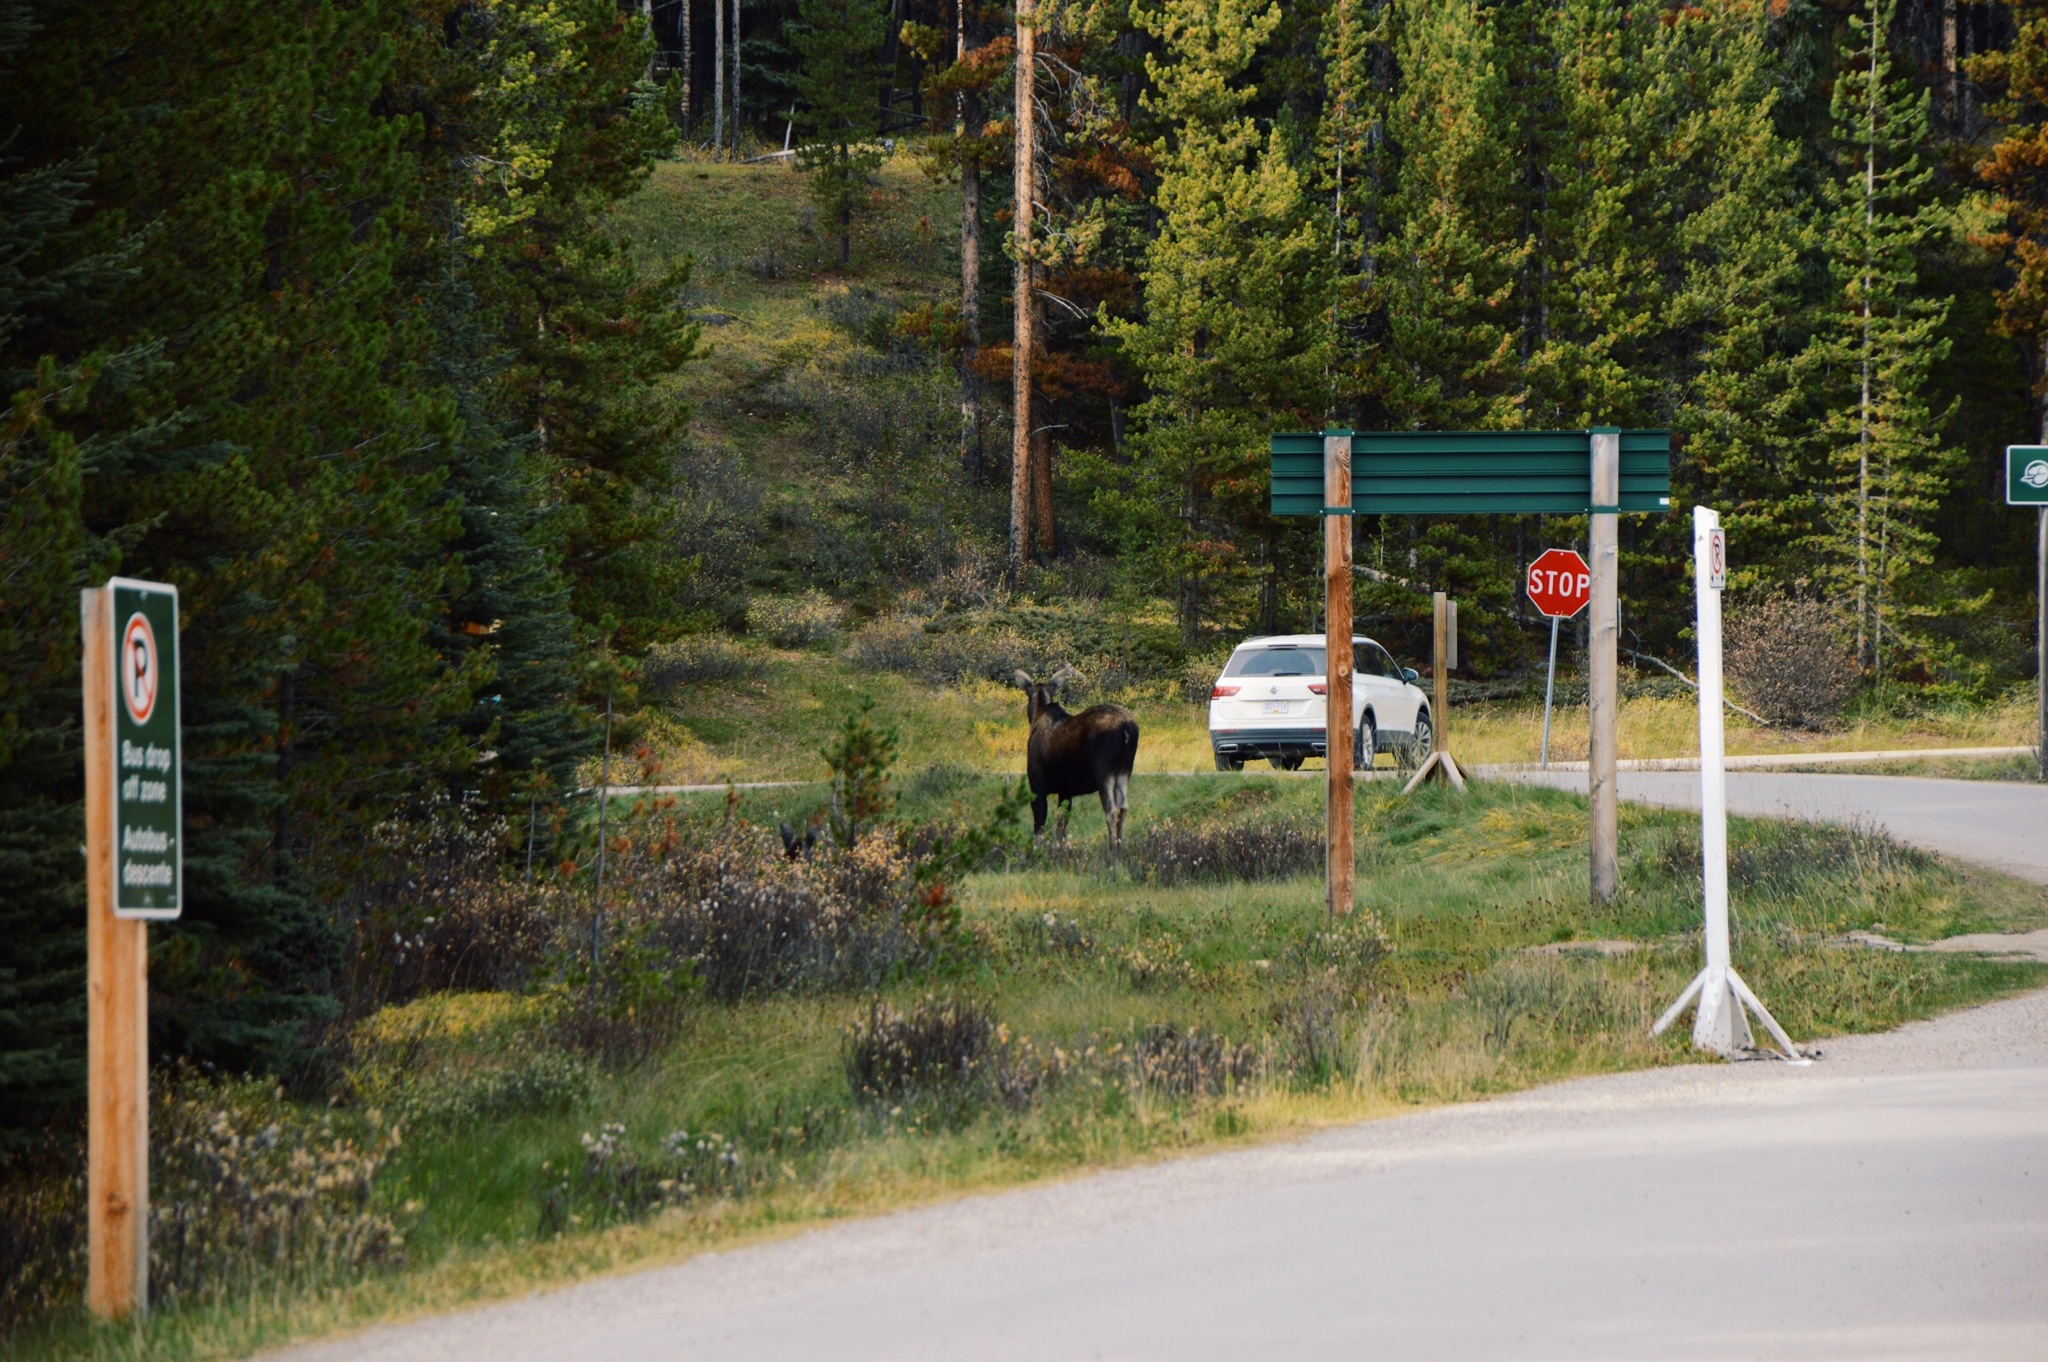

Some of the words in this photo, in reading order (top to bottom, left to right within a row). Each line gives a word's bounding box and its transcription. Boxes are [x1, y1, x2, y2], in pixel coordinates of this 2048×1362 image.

[1530, 569, 1590, 598] STOP
[122, 739, 144, 768] Bus
[145, 741, 171, 774] drop
[122, 774, 140, 801] off
[140, 780, 167, 803] zone
[122, 824, 168, 853] Autobus
[122, 858, 173, 887] descente
